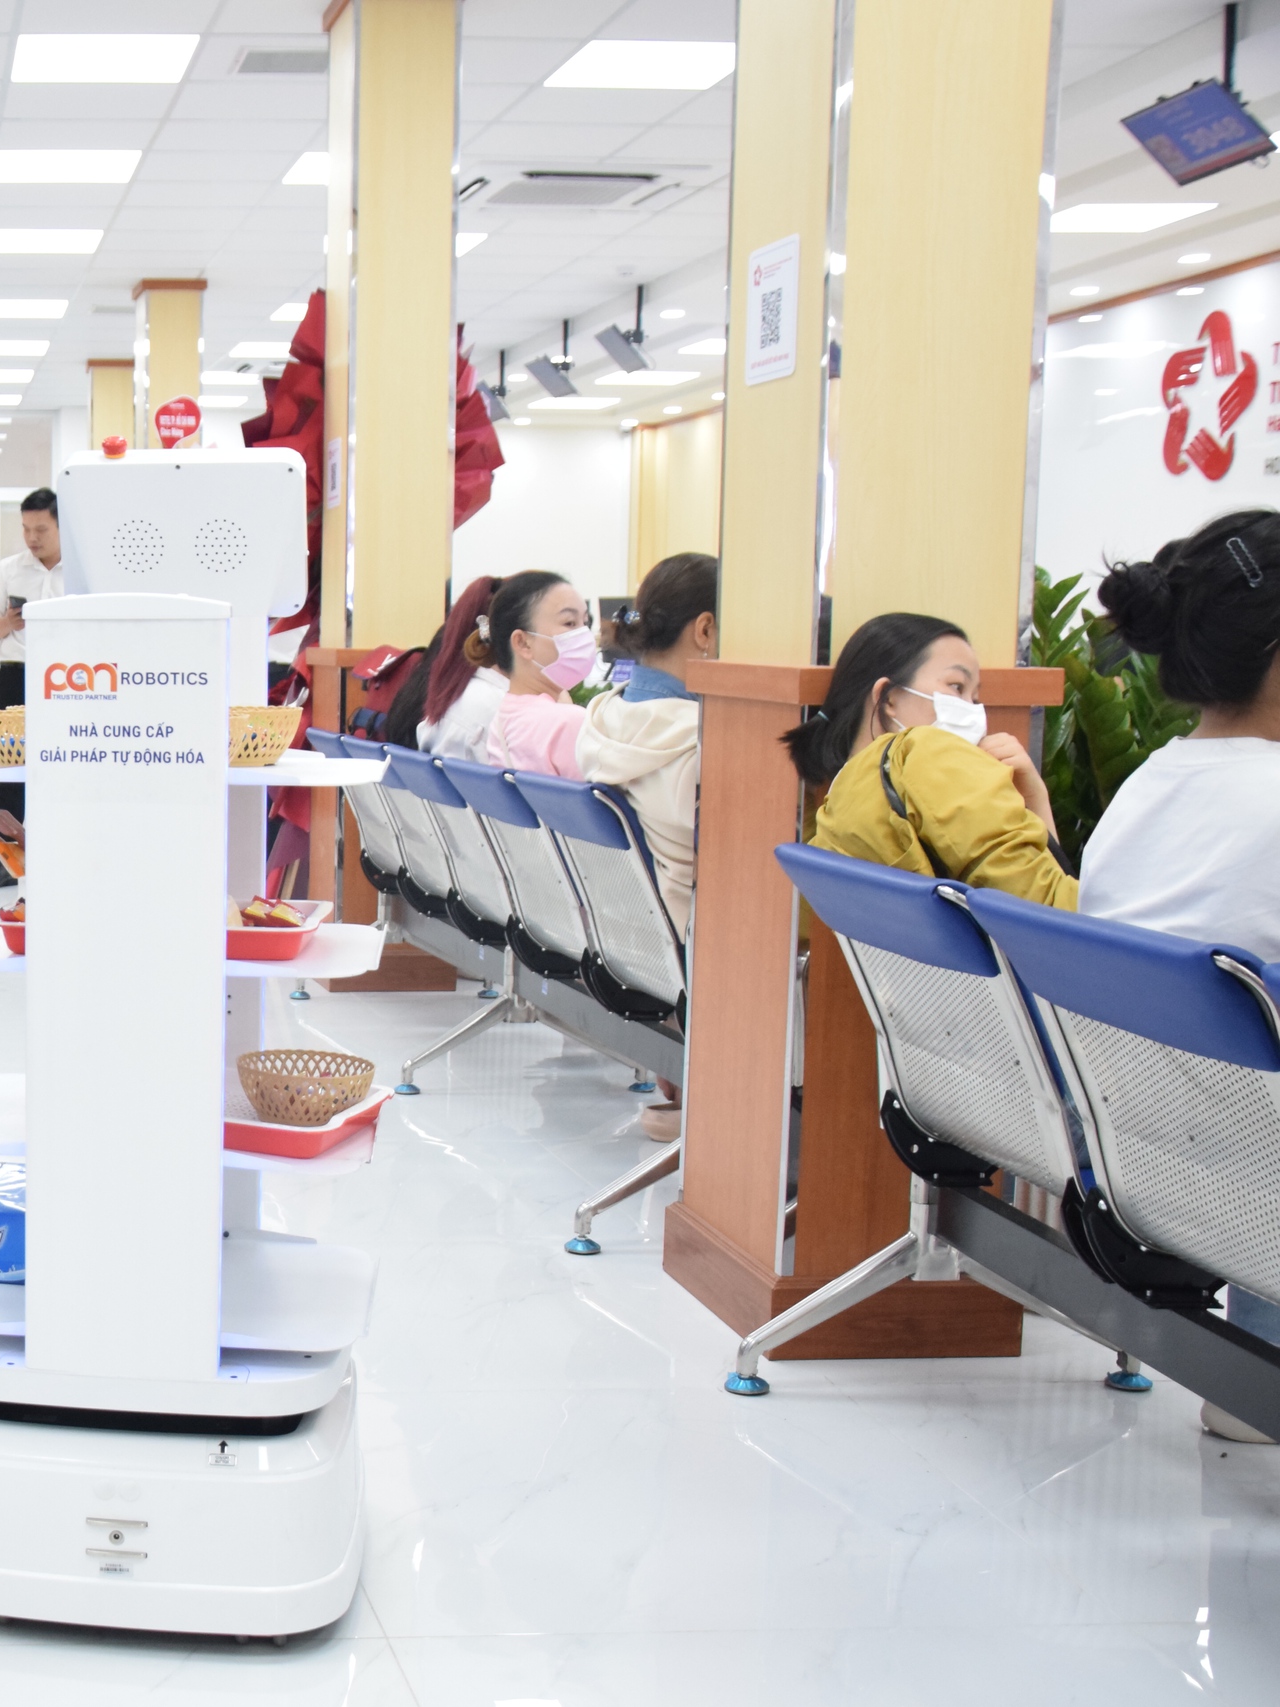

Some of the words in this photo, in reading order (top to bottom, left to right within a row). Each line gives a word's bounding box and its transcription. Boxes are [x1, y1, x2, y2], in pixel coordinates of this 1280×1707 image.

[121, 672, 208, 685] ROBOTICS
[69, 722, 99, 737] NHÀ
[103, 725, 141, 738] CUNG
[146, 722, 174, 738] CẤP
[40, 746, 67, 762] GIẢI
[70, 748, 107, 763] PHÁP
[112, 750, 131, 766] TỰ
[134, 749, 171, 766] ĐỘNG
[176, 749, 205, 764] HÓA
